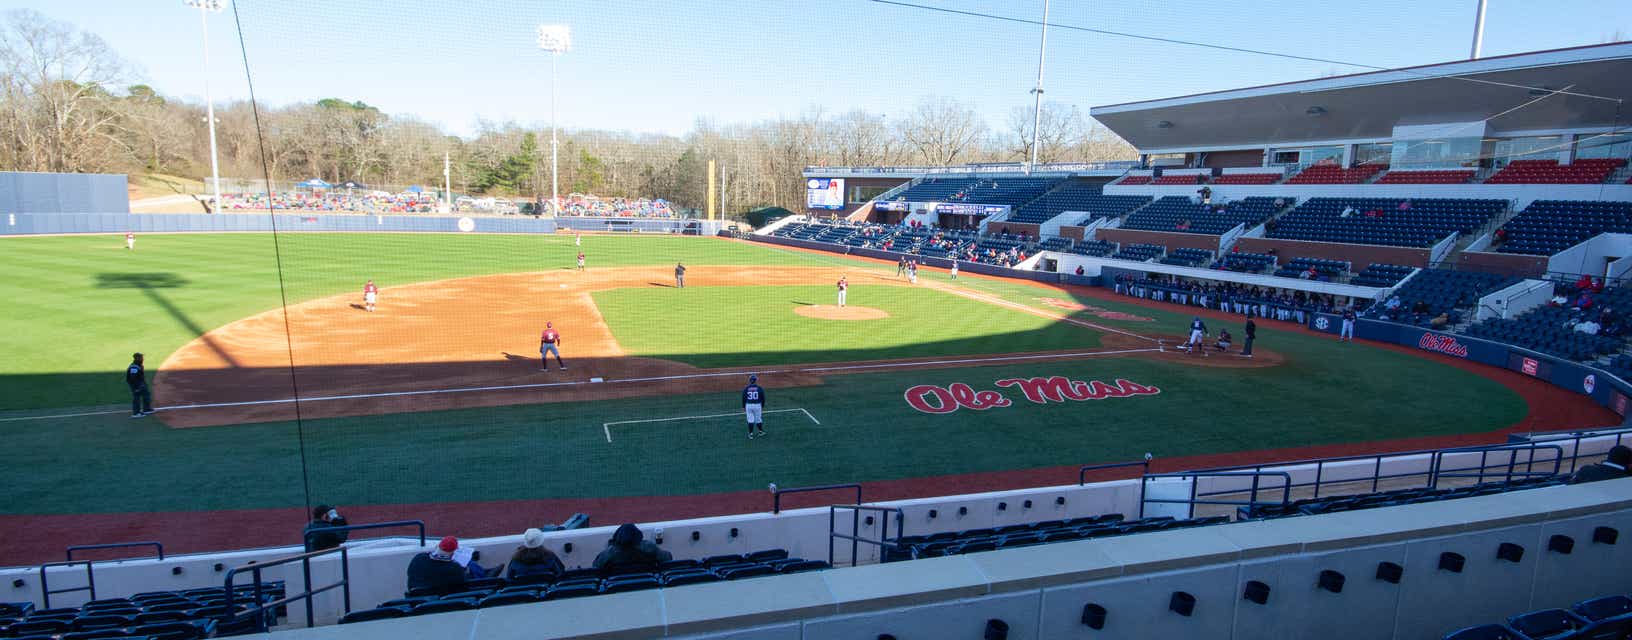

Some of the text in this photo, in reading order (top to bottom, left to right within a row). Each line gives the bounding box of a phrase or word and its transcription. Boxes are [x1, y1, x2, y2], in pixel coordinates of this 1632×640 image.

[1315, 317, 1329, 330] SEC
[1419, 332, 1468, 357] Ole Miss
[747, 391, 759, 400] 30
[904, 376, 1160, 414] Ole Miss
